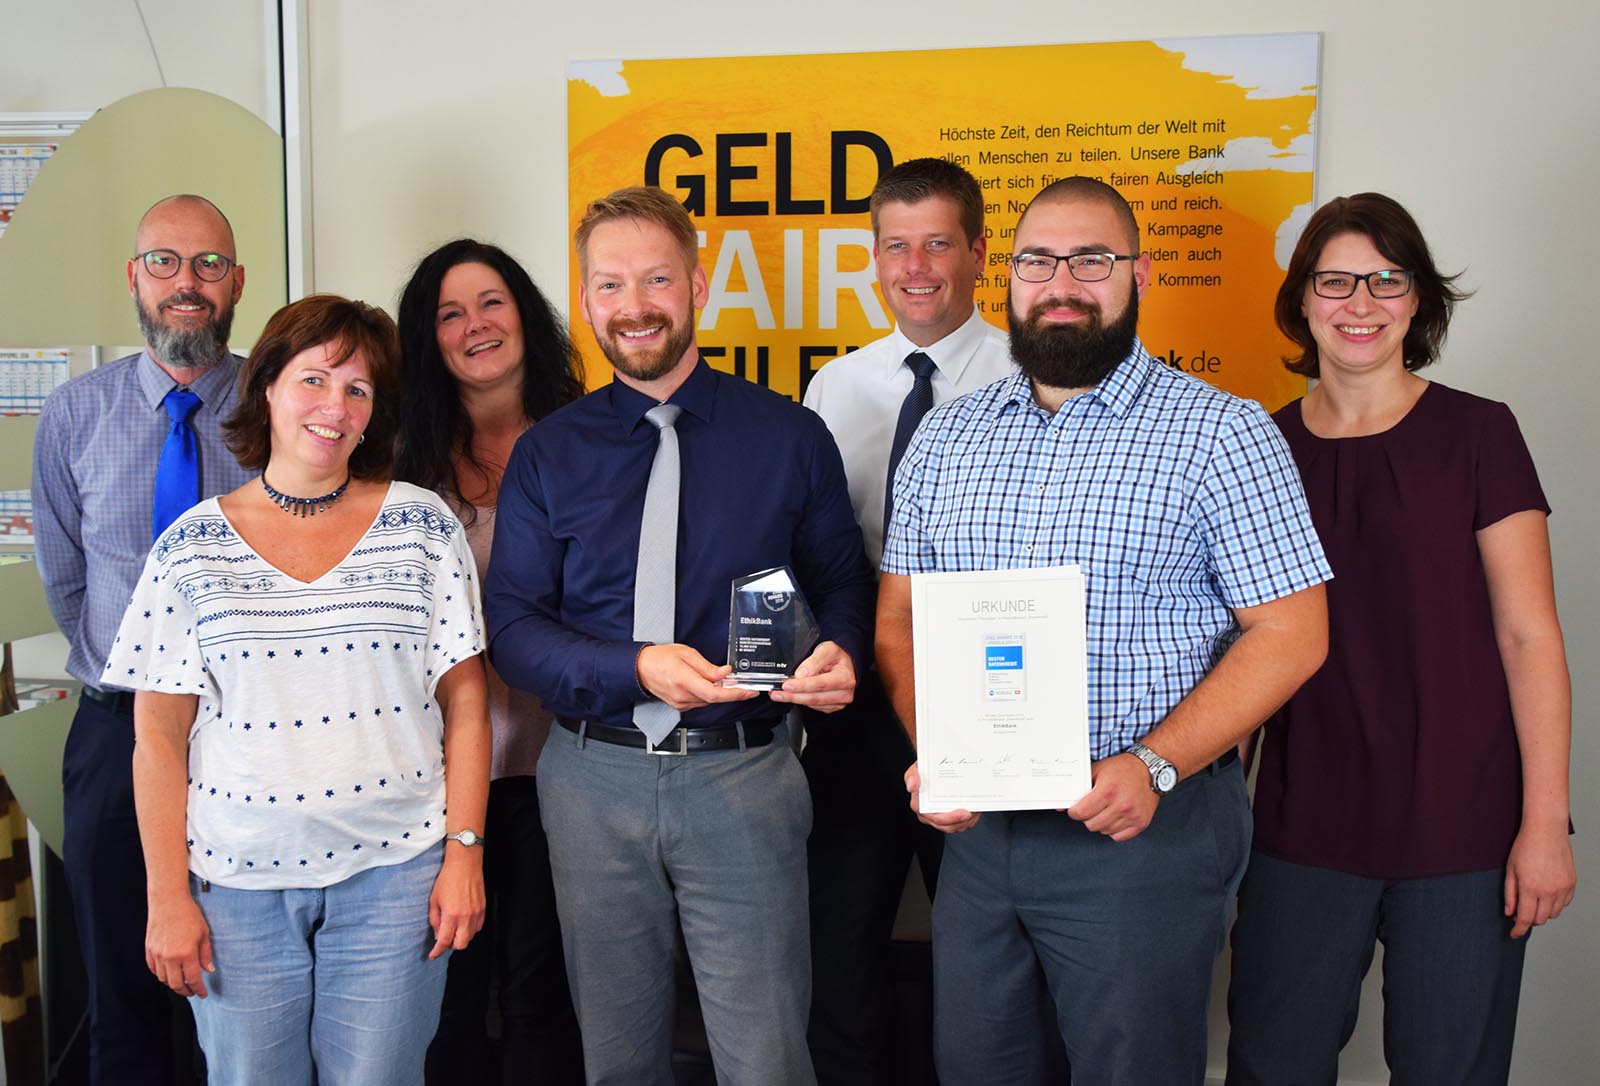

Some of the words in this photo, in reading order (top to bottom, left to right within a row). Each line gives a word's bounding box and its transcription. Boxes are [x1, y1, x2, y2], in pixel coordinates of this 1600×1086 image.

[940, 126, 996, 141] Höchste
[1000, 125, 1030, 140] Zeit,
[1035, 124, 1060, 138] den
[1066, 123, 1132, 137] Reichtum
[1137, 121, 1160, 135] der
[1165, 120, 1198, 134] Welt
[1202, 119, 1226, 133] mit
[979, 151, 1048, 164] Menschen
[1056, 152, 1072, 162] zu
[1080, 147, 1121, 162] teilen.
[1130, 146, 1180, 160] Unsere
[1188, 145, 1225, 159] Bank
[644, 130, 894, 217] GELD
[1007, 175, 1034, 189] sich
[1110, 172, 1148, 186] fairen
[1156, 170, 1224, 187] Ausgleich
[1151, 196, 1177, 210] und
[1184, 196, 1223, 210] reich.
[1147, 222, 1223, 238] Kampagne
[1187, 247, 1222, 260] auch
[698, 229, 891, 330] AIR
[1158, 273, 1222, 287] Kommen
[972, 600, 1035, 614] URKUNDE
[740, 616, 773, 625] EthikBank
